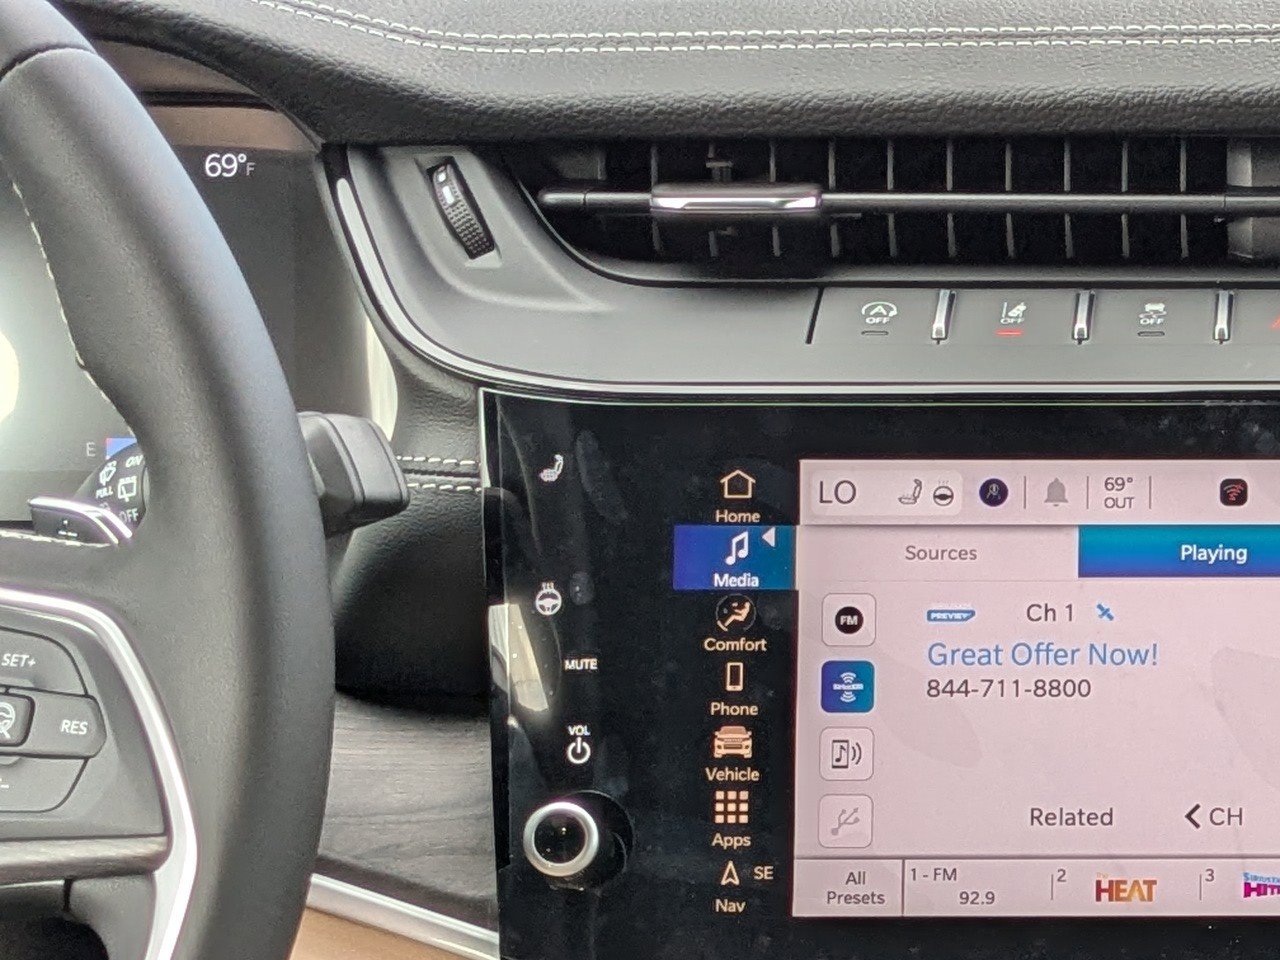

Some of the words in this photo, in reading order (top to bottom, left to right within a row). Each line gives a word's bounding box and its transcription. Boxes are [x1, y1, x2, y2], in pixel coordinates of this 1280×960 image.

[865, 316, 890, 324] OFF
[1139, 317, 1164, 325] OFF
[86, 442, 96, 457] E
[1104, 476, 1134, 492] 69°
[818, 479, 857, 504] LO
[1104, 496, 1135, 510] OUT
[715, 509, 761, 523] Home
[905, 545, 978, 561] Sources
[1181, 544, 1248, 565] Playing
[713, 572, 760, 588] Media
[1026, 603, 1057, 623] Ch
[1064, 604, 1074, 622] 1
[839, 615, 859, 626] FM
[704, 636, 767, 652] Comfort
[927, 643, 1004, 667] Great
[1011, 642, 1081, 667] Offer
[1088, 643, 1159, 667] Now!
[564, 658, 598, 671] MUTE
[926, 679, 1092, 699] 844-711-8800
[710, 702, 759, 716] Phone
[60, 719, 89, 735] RES
[568, 725, 591, 736] VOL
[705, 768, 760, 782] Vehicle
[1030, 808, 1114, 827] Related
[1209, 808, 1243, 826] CH
[712, 834, 751, 849] Apps
[753, 867, 774, 880] SE
[845, 871, 867, 885] All
[910, 868, 918, 881] 1
[933, 868, 958, 882] FM
[1057, 869, 1067, 882] 2
[1204, 869, 1215, 882] 3
[1095, 879, 1158, 902] HEAT
[826, 891, 886, 905] Presets
[959, 891, 996, 905] 92.9
[715, 899, 746, 913] Nav
